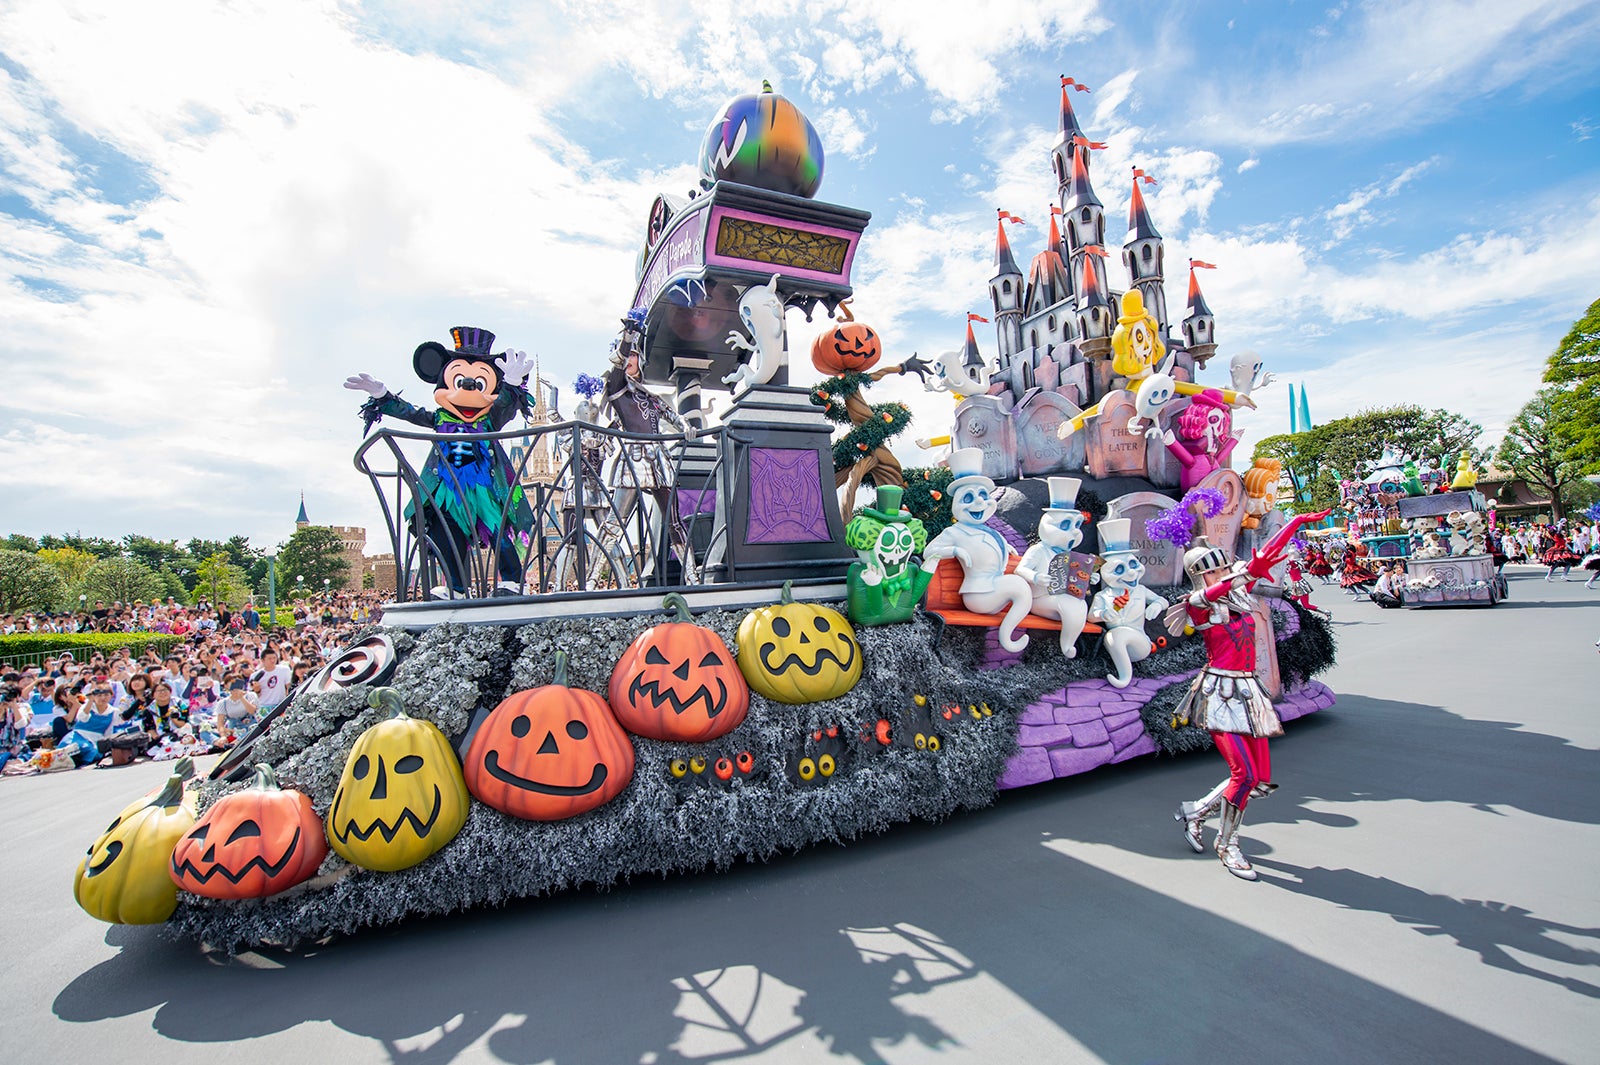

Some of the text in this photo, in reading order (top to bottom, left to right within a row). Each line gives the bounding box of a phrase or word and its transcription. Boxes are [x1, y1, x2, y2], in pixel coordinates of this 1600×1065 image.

[669, 231, 692, 260] Parade
[1108, 442, 1138, 452] LATER
[1034, 447, 1067, 459] GONE
[1137, 555, 1166, 566] OOK
